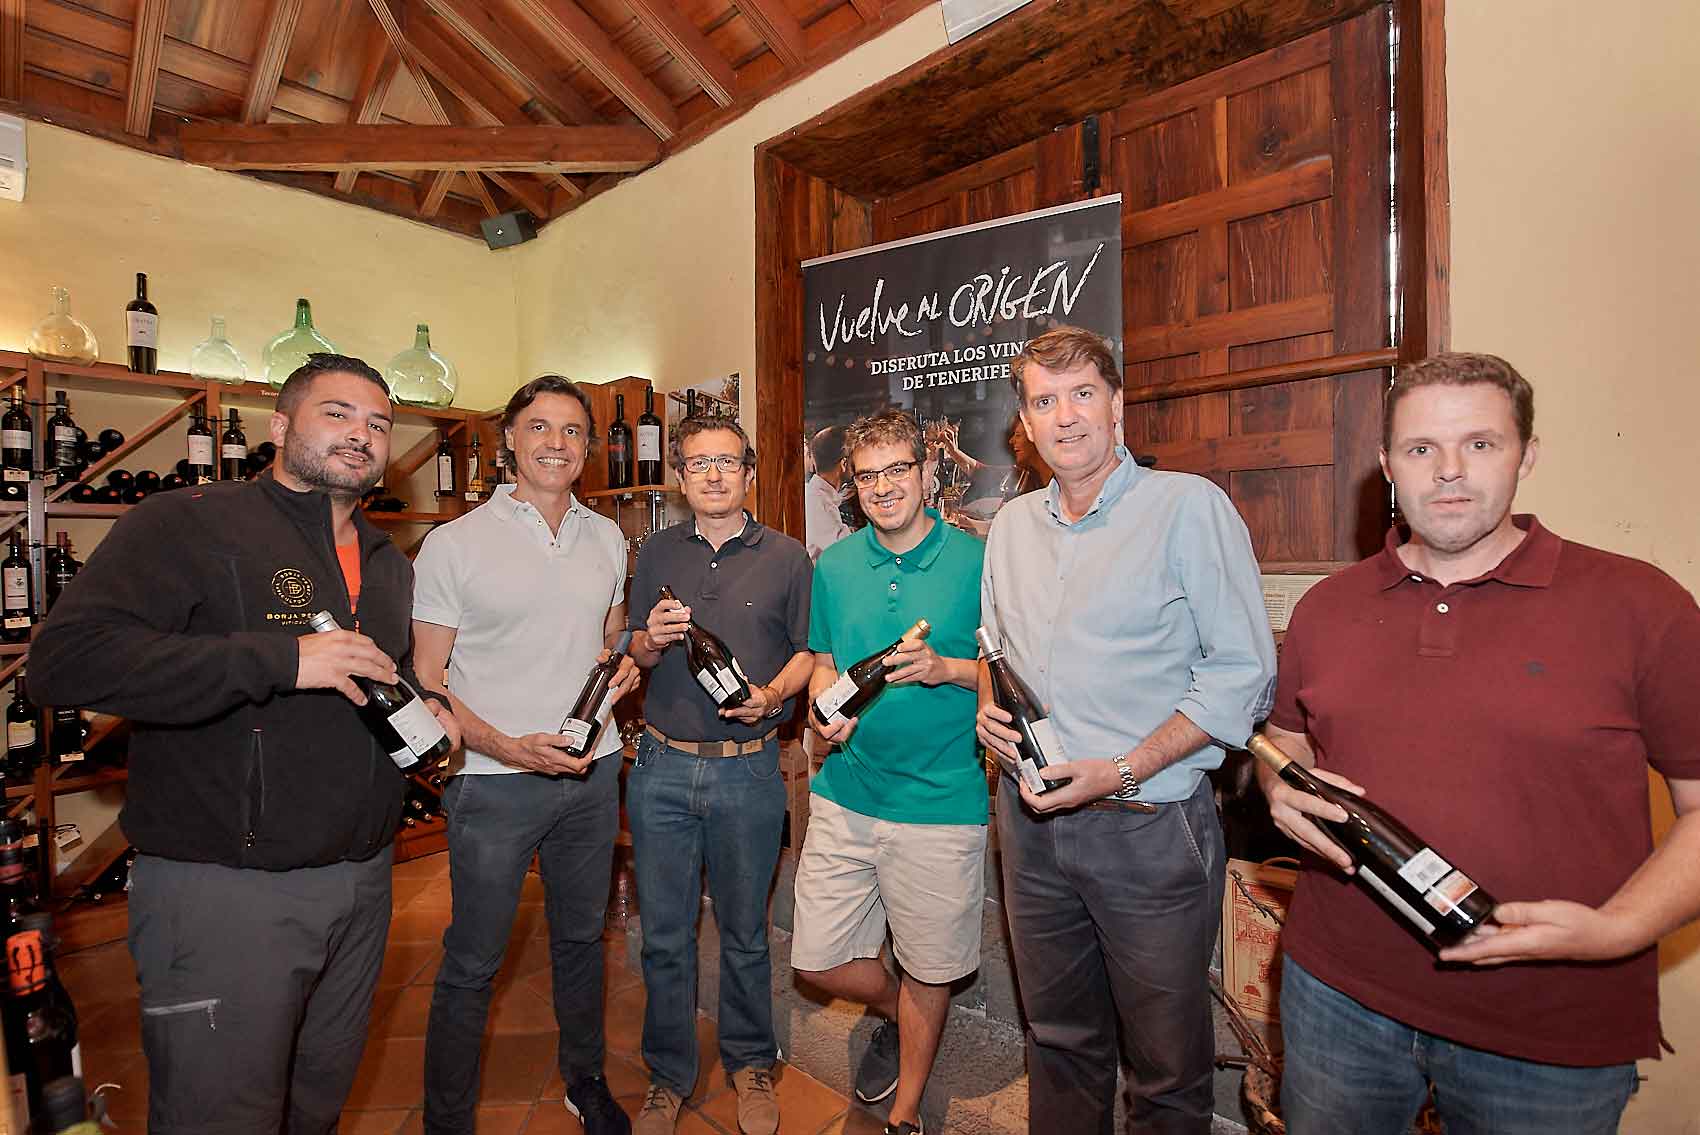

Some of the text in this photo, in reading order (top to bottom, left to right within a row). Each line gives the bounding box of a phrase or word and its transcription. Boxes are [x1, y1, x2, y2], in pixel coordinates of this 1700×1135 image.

[819, 278, 922, 351] Vuelve
[917, 291, 943, 322] AL
[870, 341, 1025, 375] DISFRUTA LOS VIN
[902, 363, 1011, 391] DE TENERIFE
